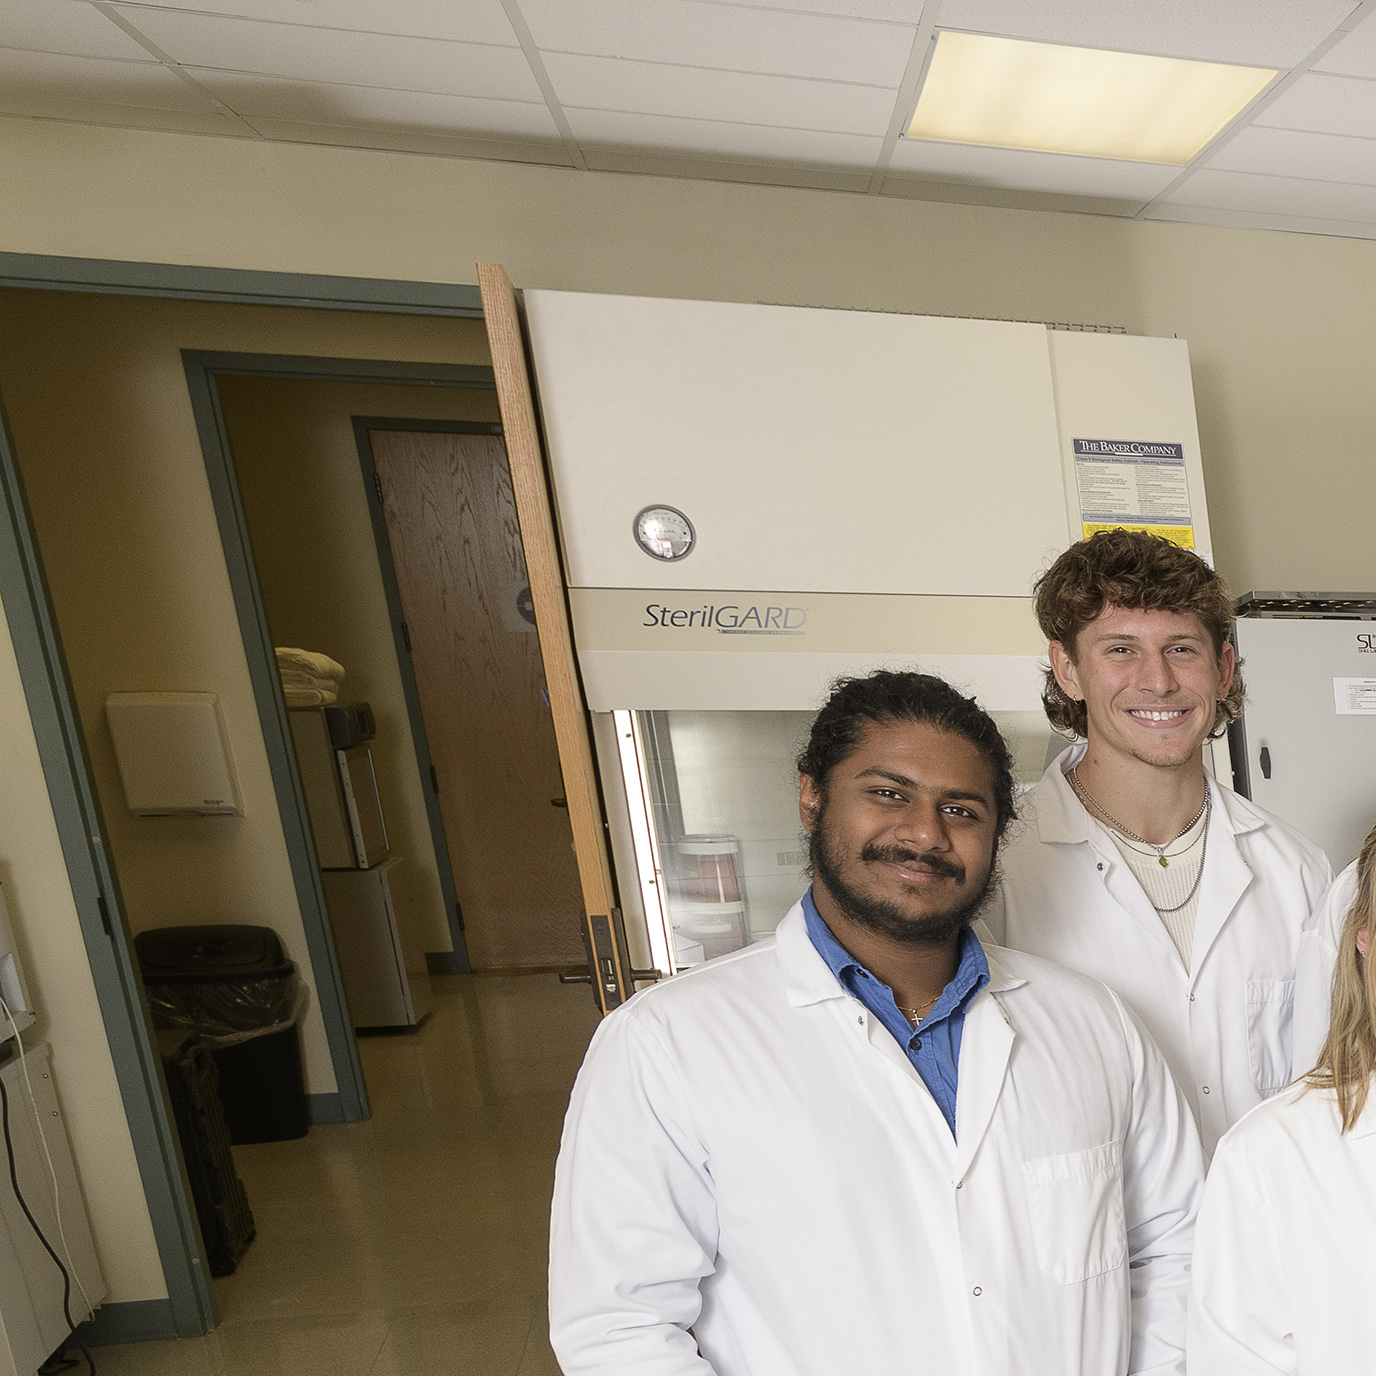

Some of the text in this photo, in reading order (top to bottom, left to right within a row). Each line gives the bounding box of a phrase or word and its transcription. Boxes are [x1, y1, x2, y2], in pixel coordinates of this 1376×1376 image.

[1079, 440, 1178, 456] THE BAKER COMPANY
[642, 604, 808, 630] SterilGARD
